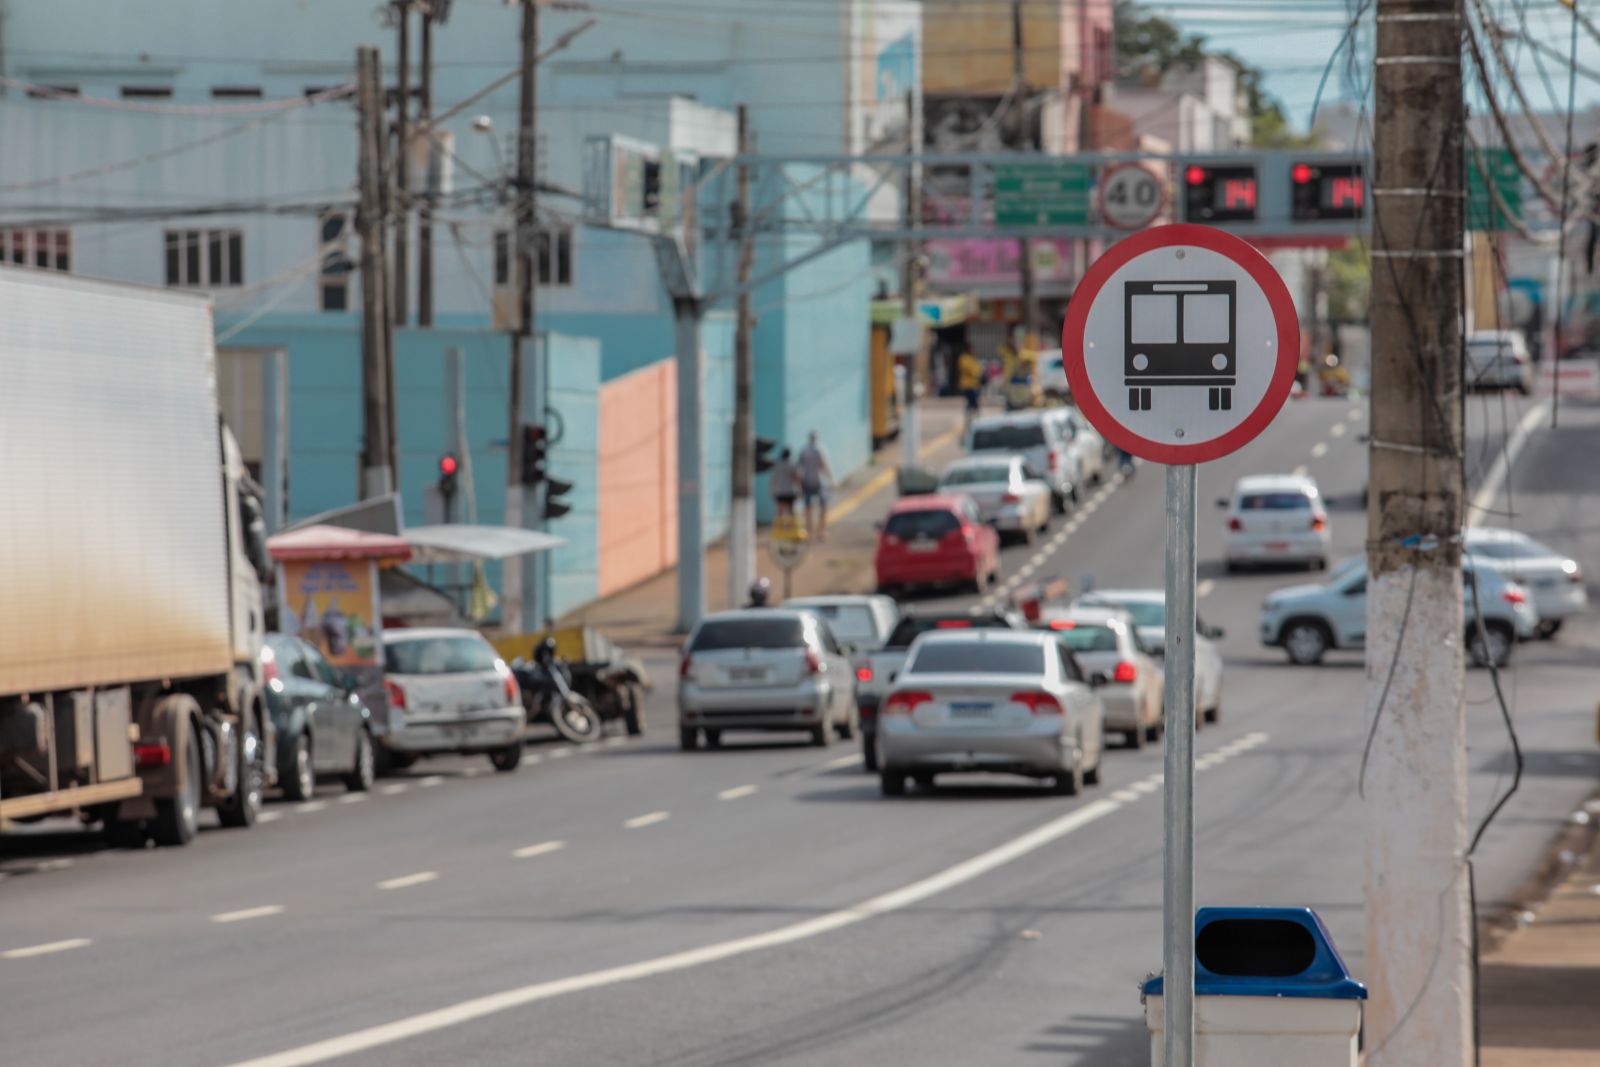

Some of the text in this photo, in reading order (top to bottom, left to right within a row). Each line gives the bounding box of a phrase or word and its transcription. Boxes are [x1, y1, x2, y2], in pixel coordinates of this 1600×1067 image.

[1108, 180, 1156, 207] 40
[1225, 179, 1256, 209] 14
[1332, 177, 1364, 209] 14
